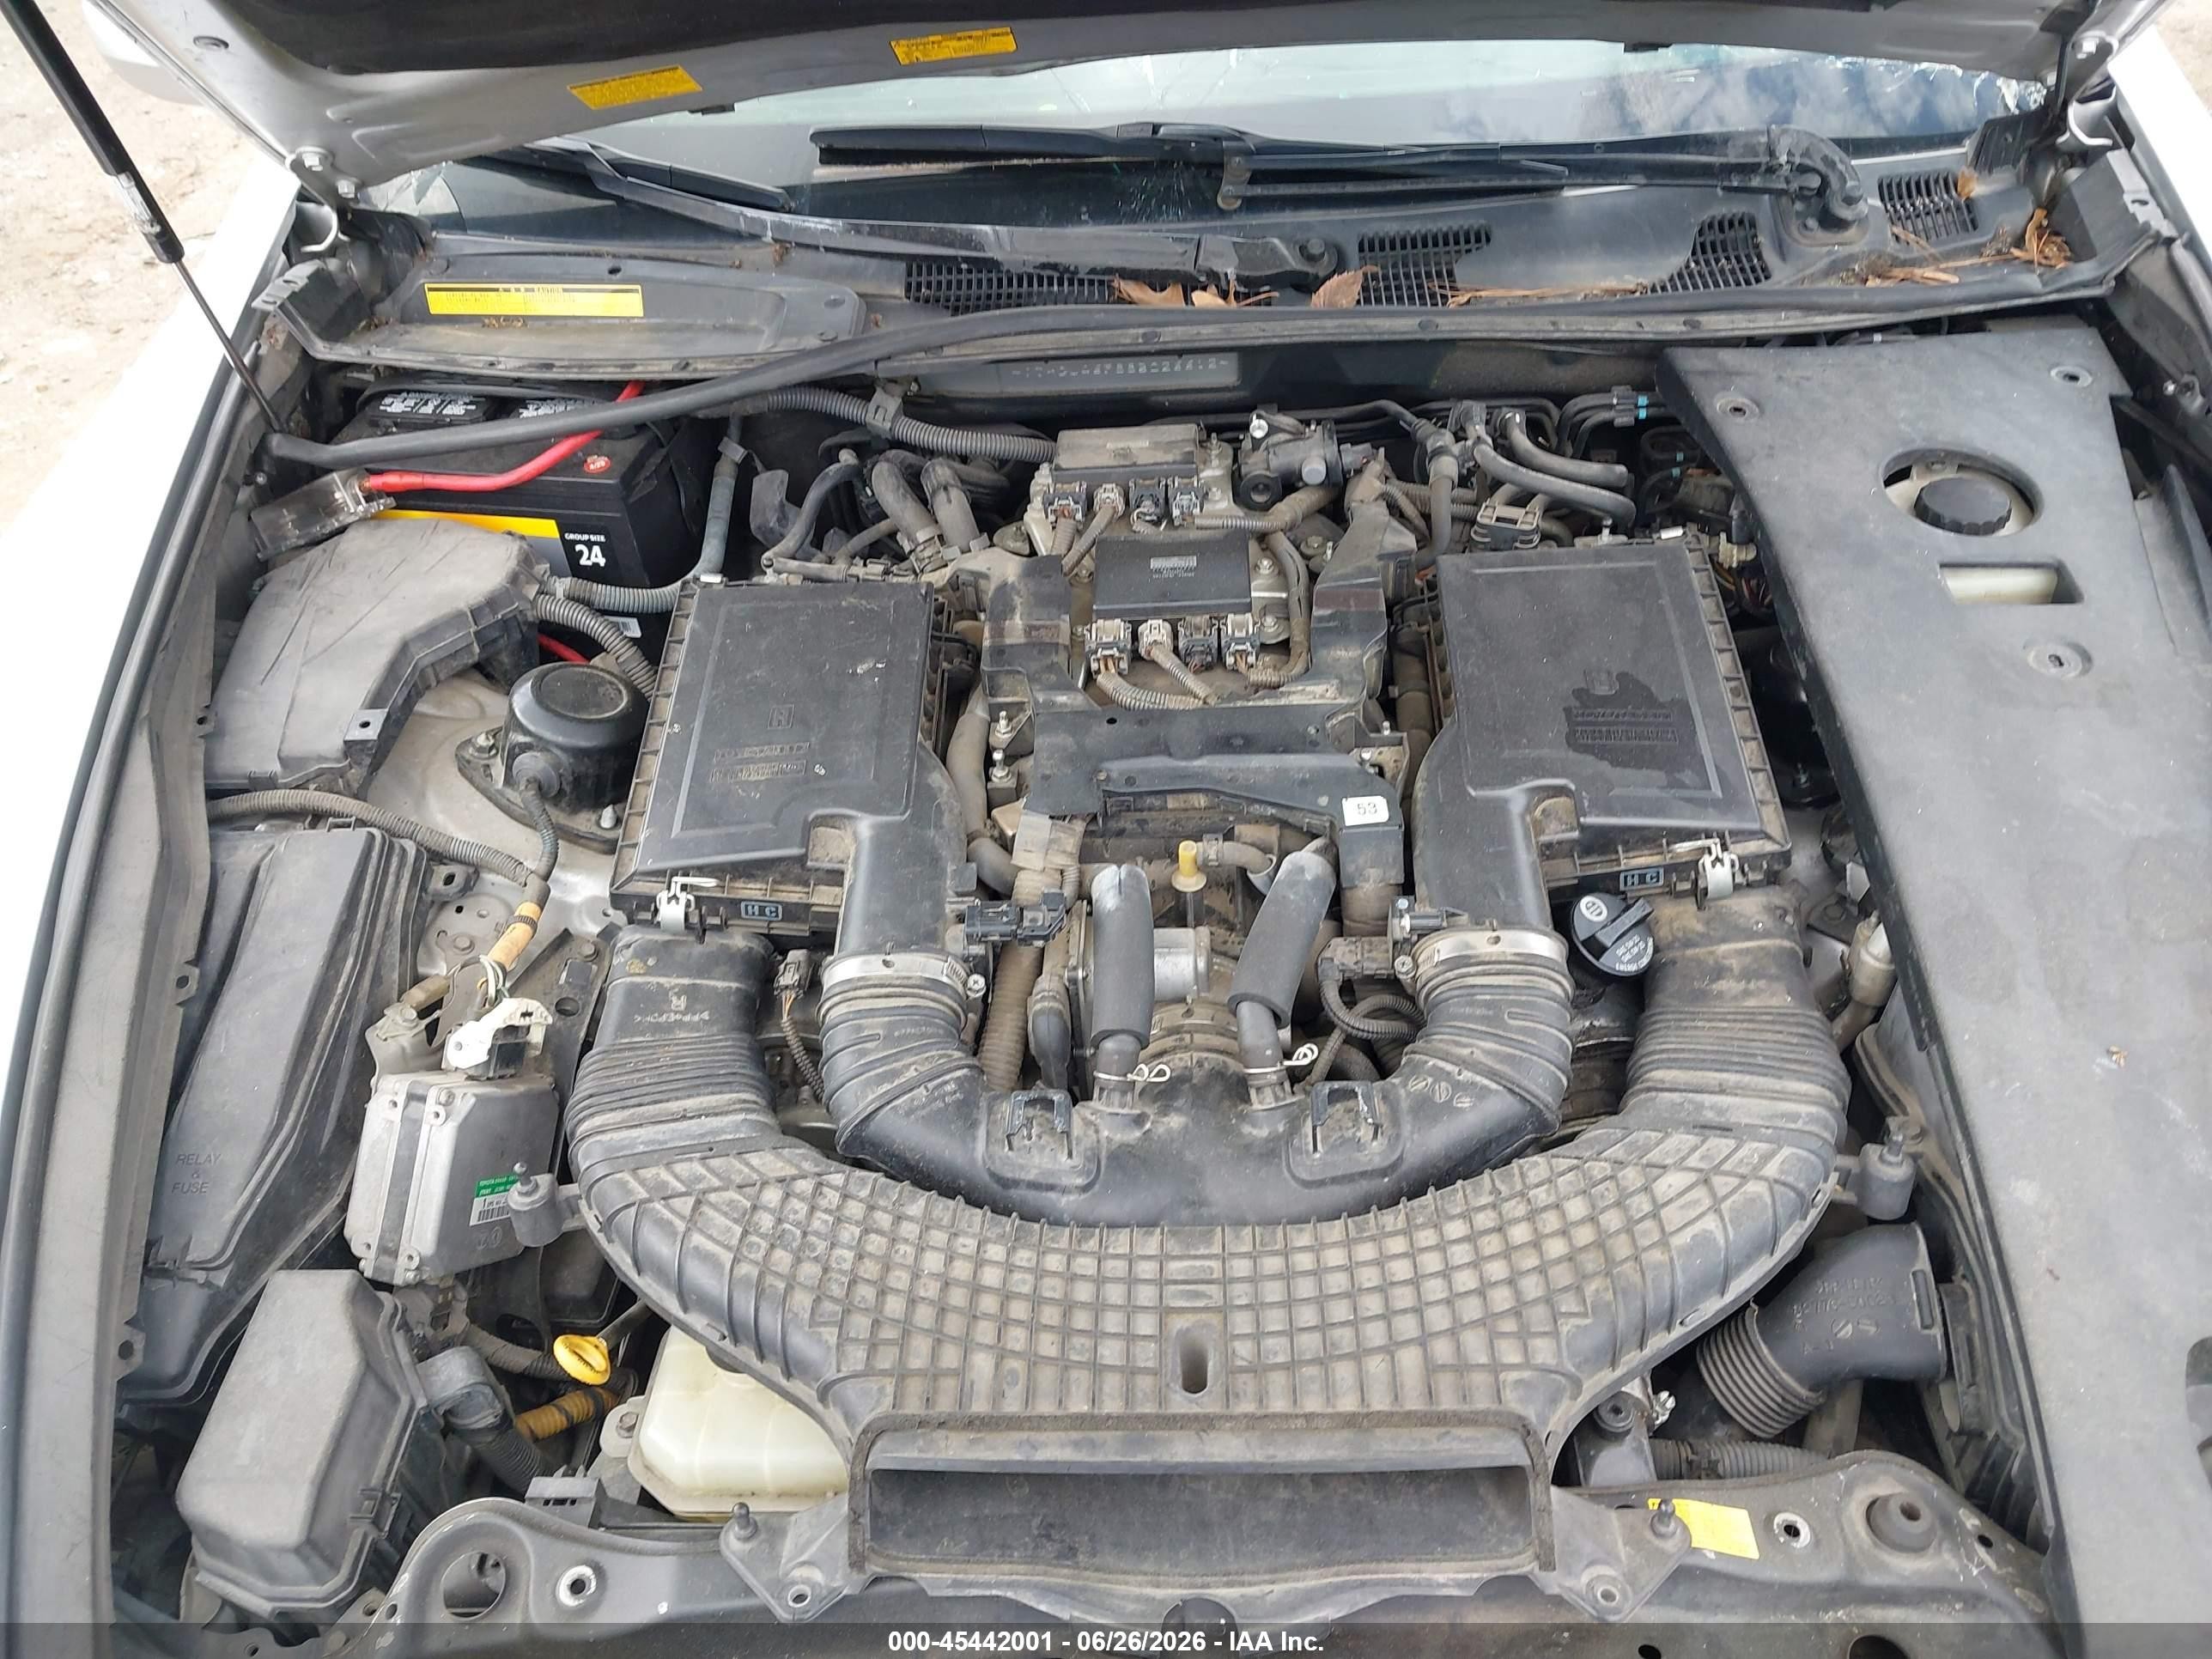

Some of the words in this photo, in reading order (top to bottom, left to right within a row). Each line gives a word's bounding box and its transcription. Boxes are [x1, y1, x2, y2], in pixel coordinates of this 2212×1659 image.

[564, 532, 589, 541] GROUP
[590, 533, 606, 543] SIZE
[574, 543, 606, 567] 24
[1357, 803, 1377, 815] 53
[175, 1153, 222, 1165] RELAY
[172, 1182, 210, 1194] FUSE
